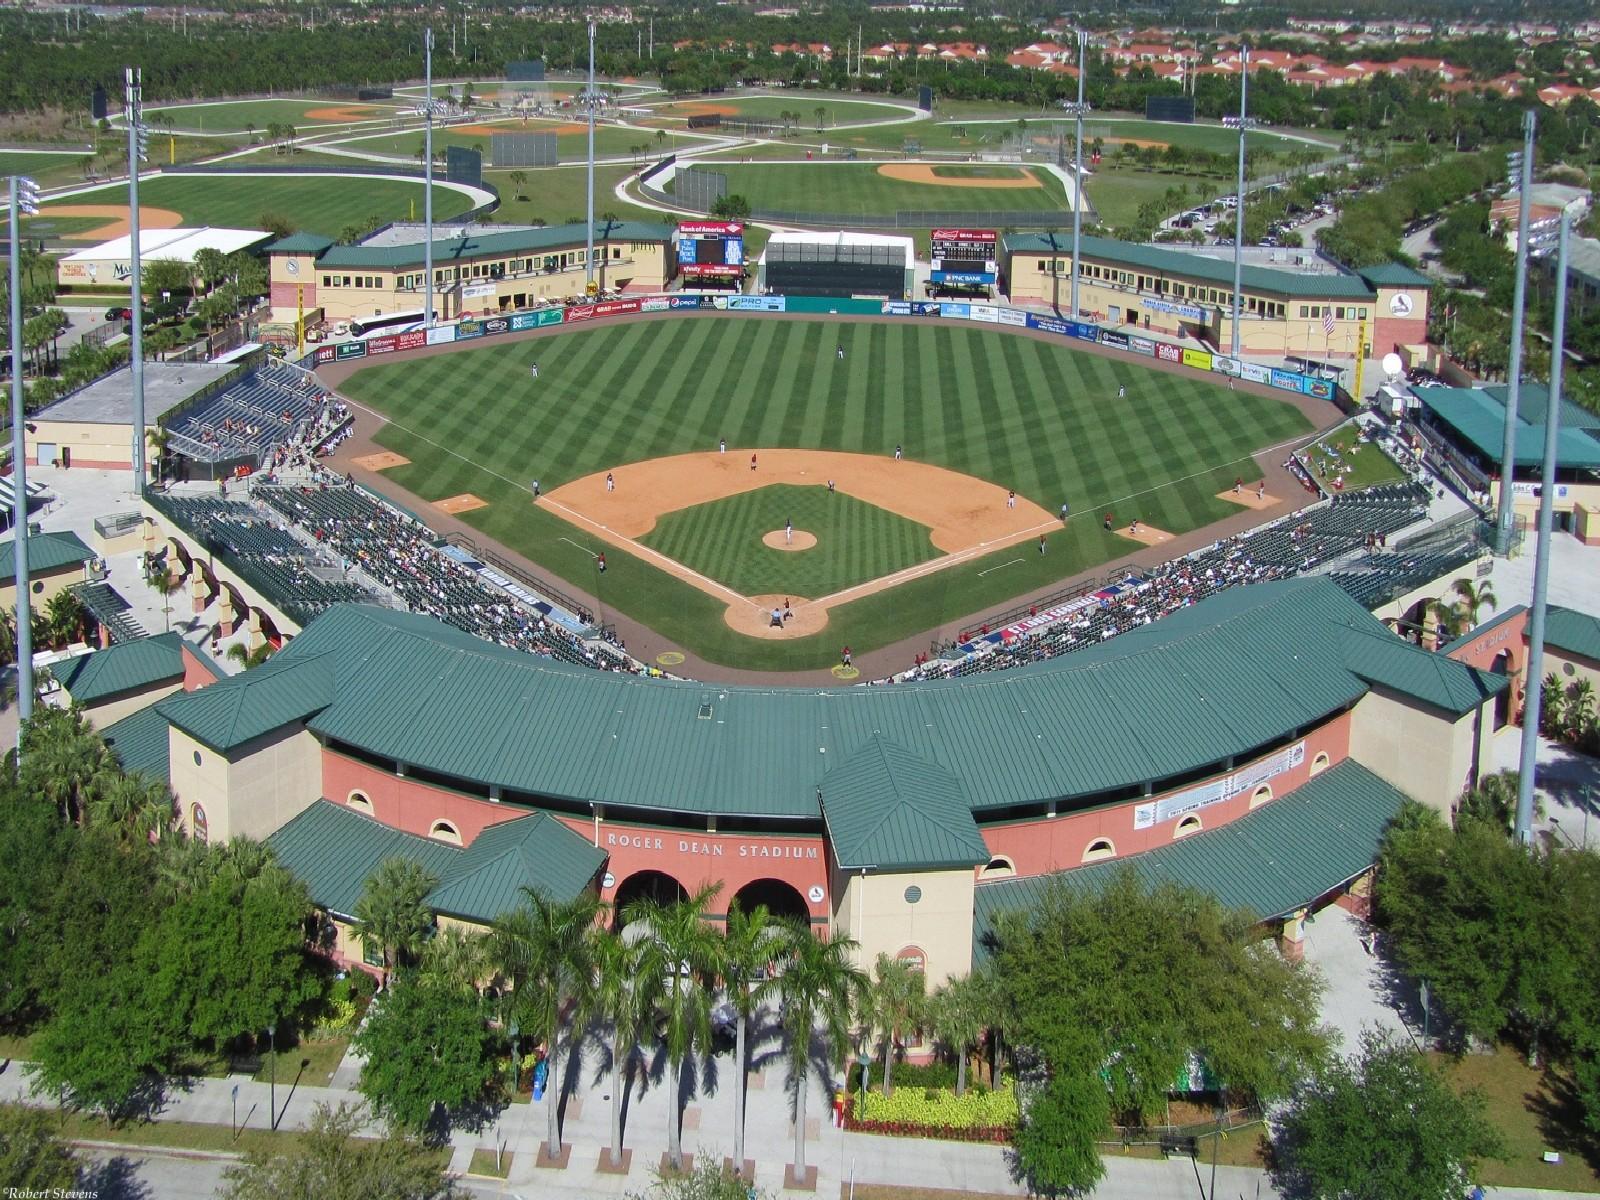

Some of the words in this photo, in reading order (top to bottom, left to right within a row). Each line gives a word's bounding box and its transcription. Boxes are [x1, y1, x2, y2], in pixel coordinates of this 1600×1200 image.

[1200, 796, 1221, 806] TRAINING
[608, 832, 663, 850] ROGER
[679, 841, 723, 856] DEAN
[739, 845, 818, 859] STADIUM
